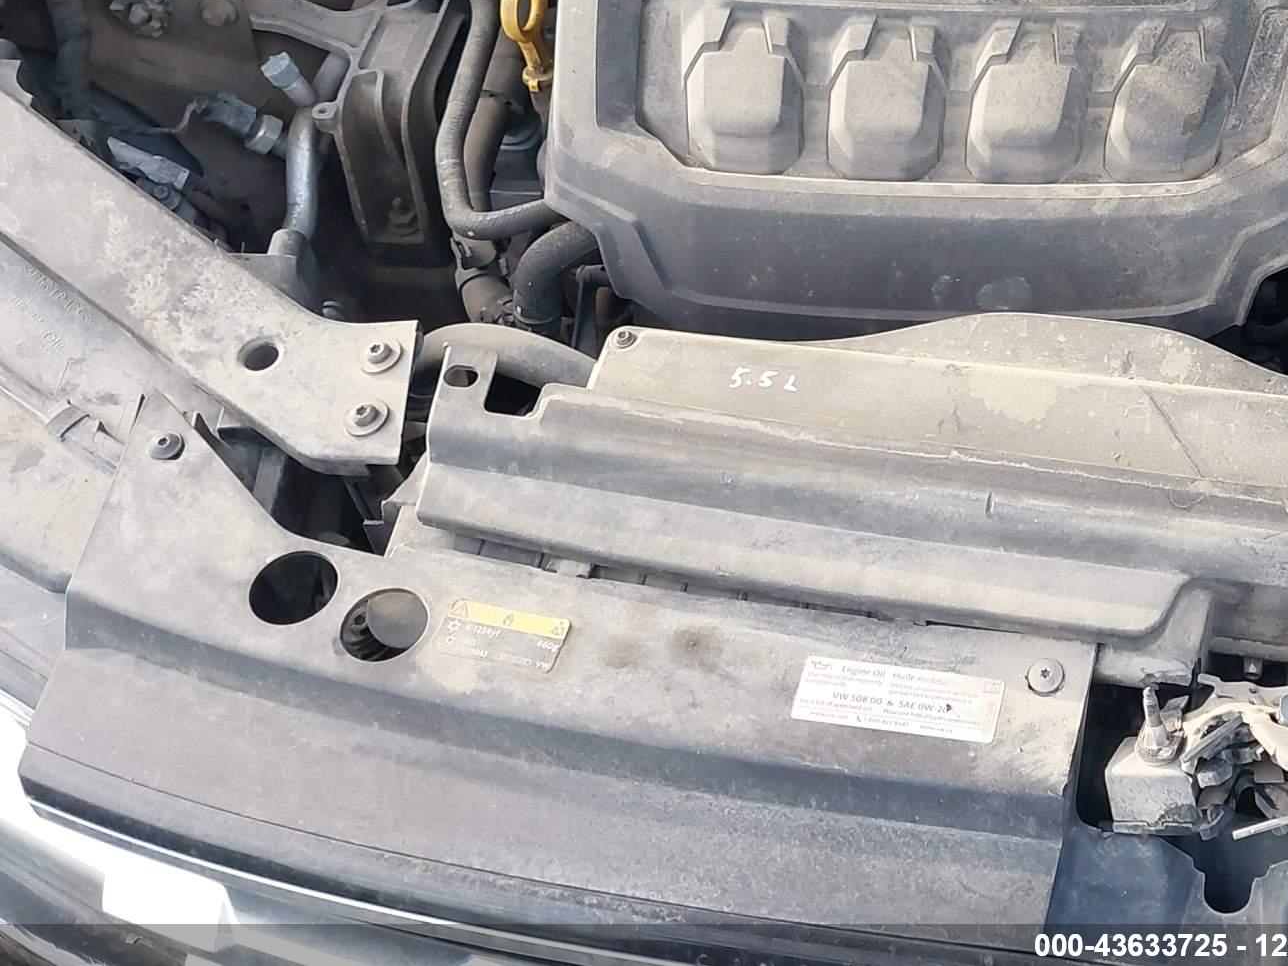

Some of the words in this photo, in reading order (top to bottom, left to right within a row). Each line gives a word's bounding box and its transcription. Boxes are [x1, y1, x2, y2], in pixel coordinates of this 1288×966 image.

[841, 666, 871, 677] Engine
[872, 669, 886, 678] Oil
[833, 692, 849, 701] VW
[898, 700, 916, 709] SAE
